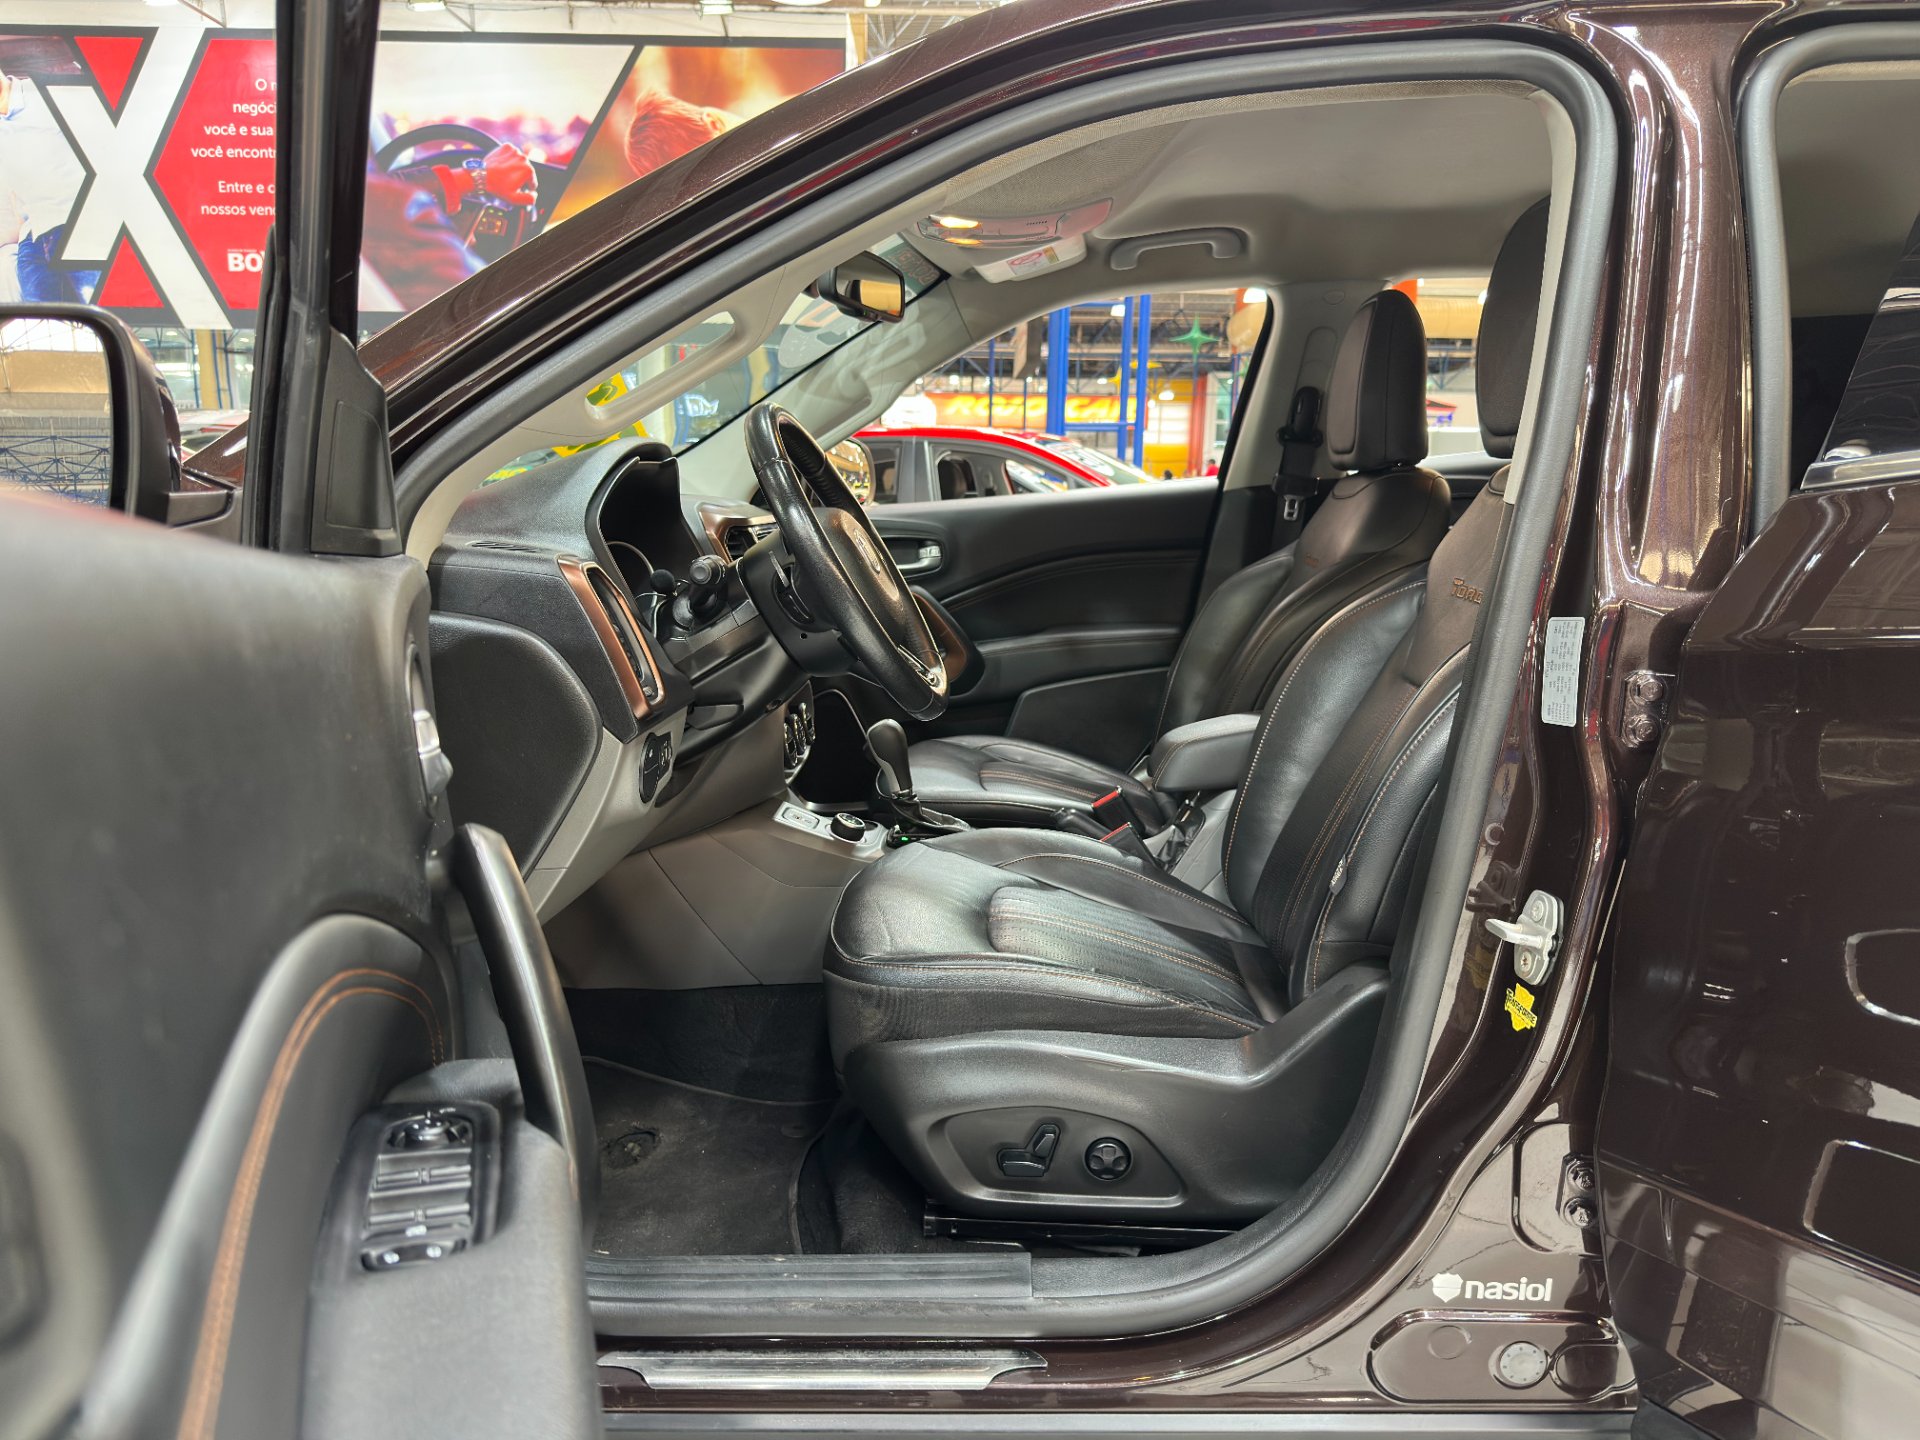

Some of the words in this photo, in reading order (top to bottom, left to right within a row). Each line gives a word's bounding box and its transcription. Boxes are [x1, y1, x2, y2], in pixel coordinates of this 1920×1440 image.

[254, 78, 267, 91] O
[203, 123, 236, 136] você
[239, 126, 248, 136] e
[250, 126, 274, 136] sua
[191, 146, 223, 158] você
[218, 181, 253, 193] Entre
[256, 184, 265, 194] e
[200, 205, 246, 216] nossos
[227, 250, 266, 273] BO
[1464, 1276, 1554, 1302] nasiol
